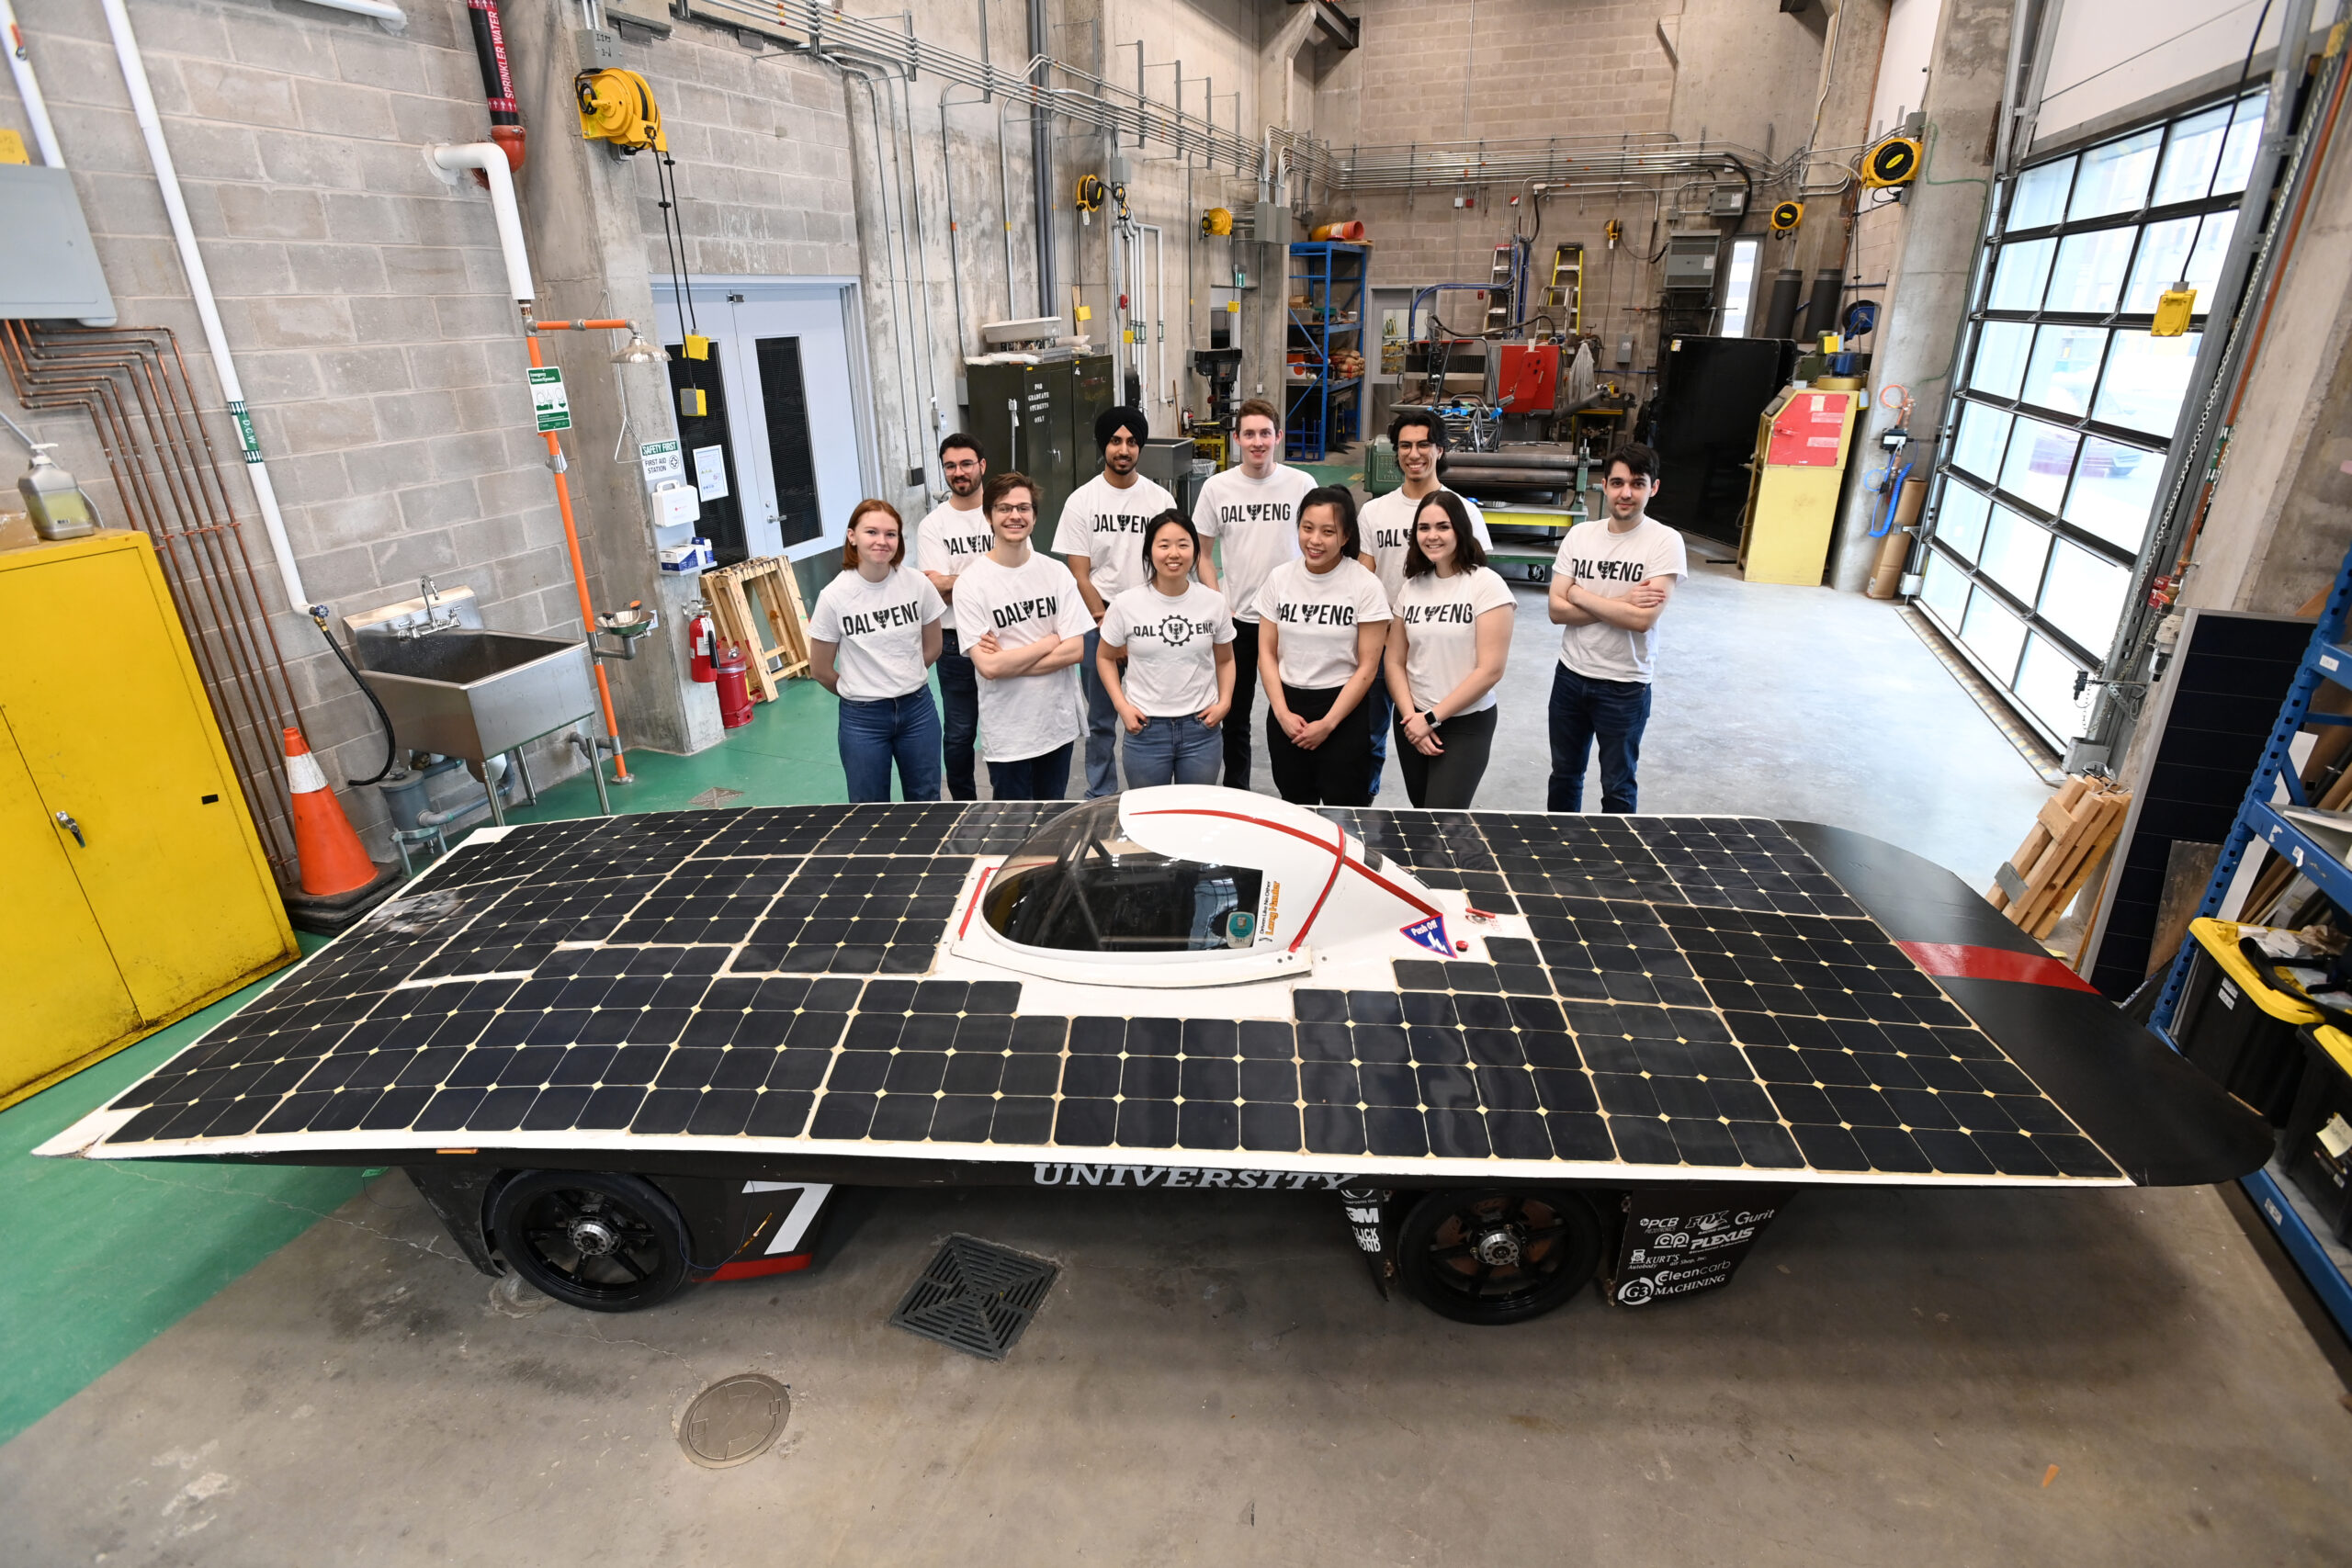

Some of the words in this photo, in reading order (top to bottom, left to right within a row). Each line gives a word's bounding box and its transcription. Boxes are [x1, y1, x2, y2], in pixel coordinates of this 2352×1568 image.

[487, 11, 504, 44] WATER
[495, 47, 514, 99] SPRINKLER
[1028, 392, 1049, 401] GRADUATE
[1030, 402, 1049, 412] STUDENTS
[1035, 415, 1045, 423] ONLY
[642, 444, 662, 456] SAFETY
[662, 441, 677, 452] FIRST
[648, 466, 667, 474] STATION
[1221, 506, 1246, 524] DAL
[1262, 502, 1291, 521] ENG
[1609, 560, 1645, 582] ENG
[993, 603, 1027, 629] DAL
[1035, 595, 1057, 618] EN
[1317, 604, 1354, 626] ENG
[1438, 603, 1474, 624] ENG
[842, 613, 876, 637] DAL
[1133, 625, 1157, 637] DAL
[1264, 897, 1270, 906] No
[1265, 912, 1279, 936] Long
[1410, 924, 1429, 936] Push
[1427, 919, 1438, 931] Off
[1034, 1163, 1358, 1190] UNIVERSITY
[741, 1180, 833, 1255] 7
[1345, 1207, 1380, 1224] 3M
[1647, 1217, 1679, 1229] PCB
[1684, 1210, 1731, 1231] FOX
[1735, 1209, 1775, 1225] Gurit
[1690, 1227, 1755, 1250] PLEXUS
[1645, 1254, 1680, 1265] KURT'S
[1654, 1259, 1731, 1285] Cleancarb
[1626, 1286, 1649, 1298] G3
[1654, 1274, 1725, 1295] MACHINING
